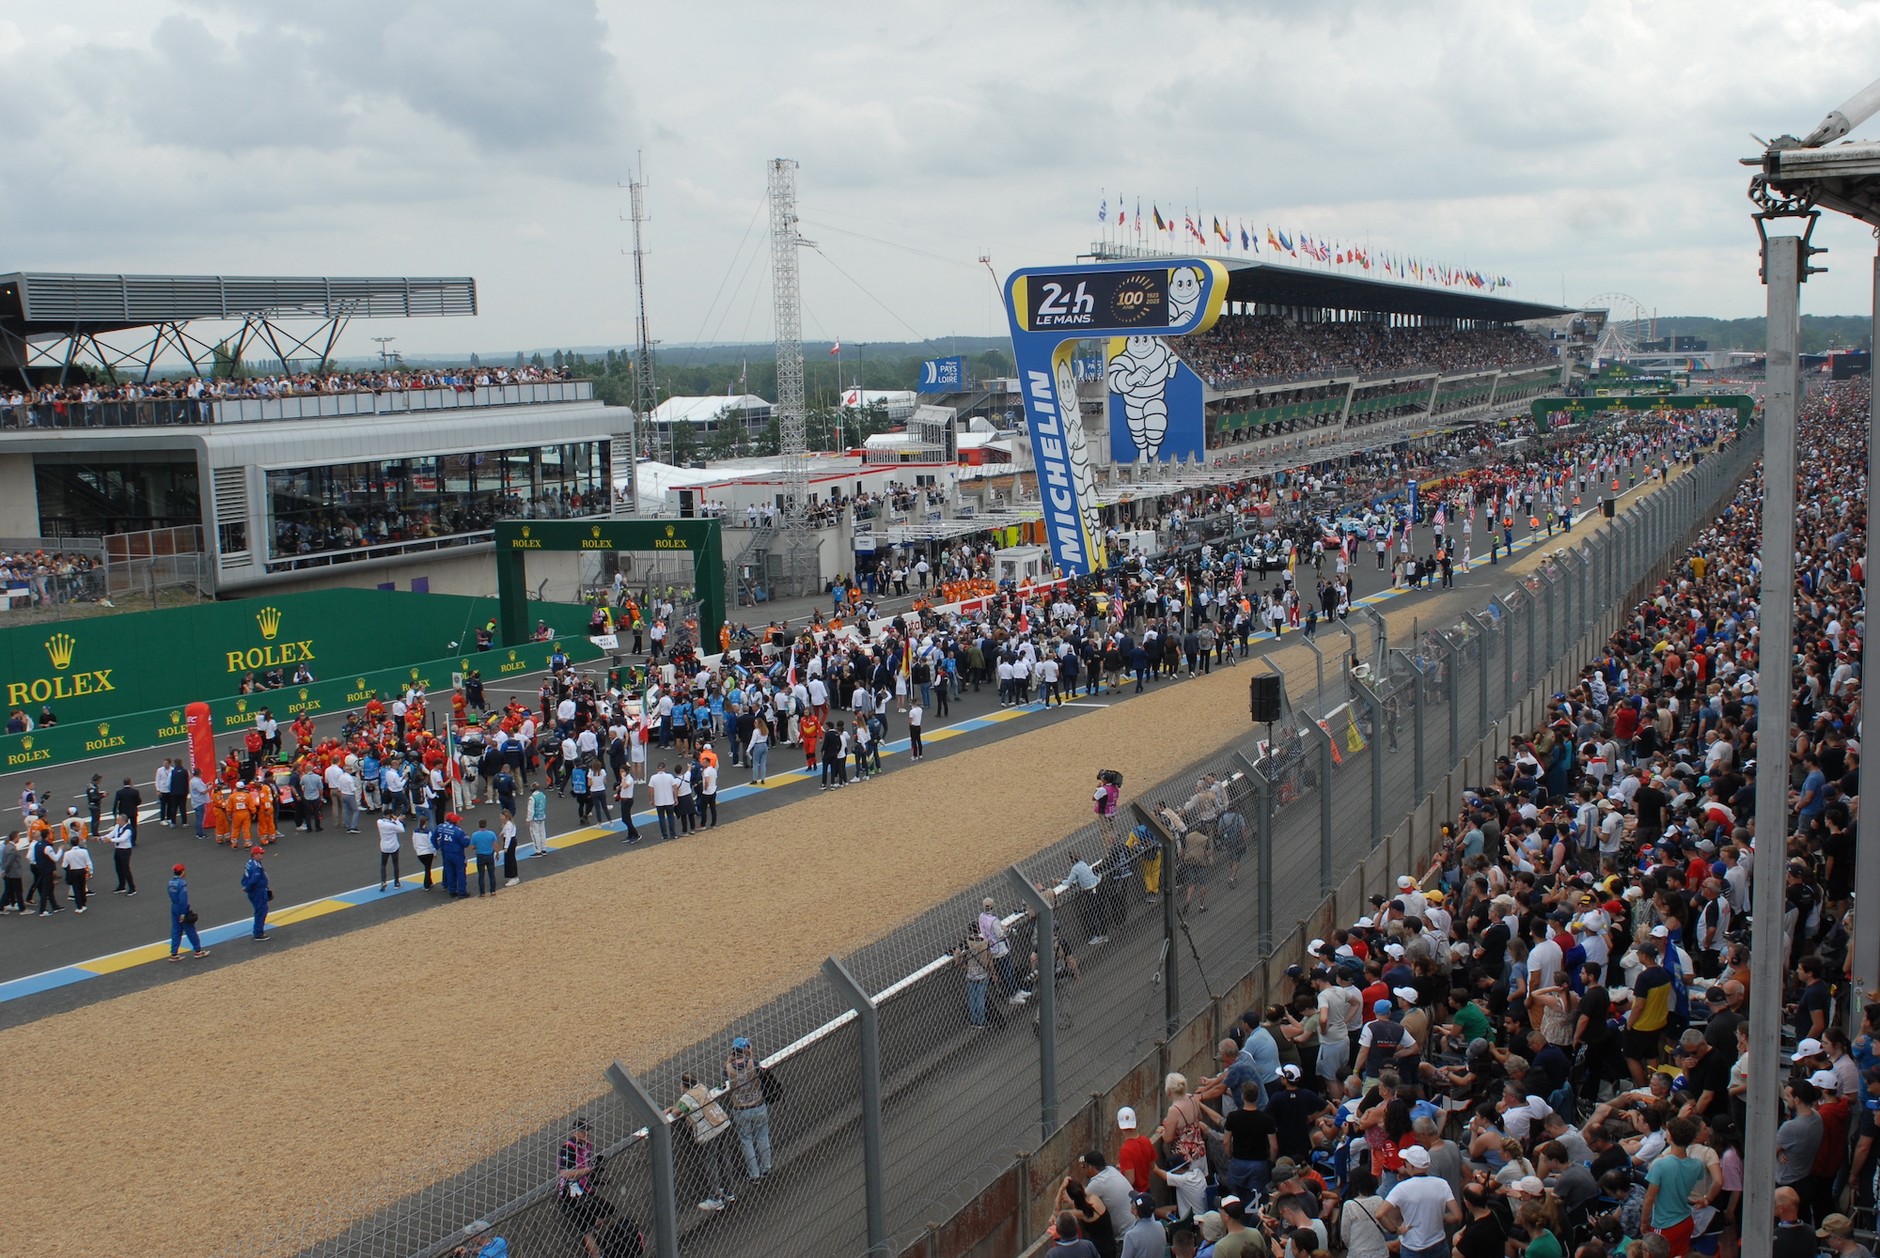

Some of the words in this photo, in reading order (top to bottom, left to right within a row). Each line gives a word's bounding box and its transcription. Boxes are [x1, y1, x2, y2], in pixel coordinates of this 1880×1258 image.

[1038, 281, 1094, 315] 24h
[1117, 291, 1144, 305] 100
[1036, 315, 1052, 325] LE
[1053, 314, 1092, 324] MANS
[940, 365, 957, 373] PAYS
[937, 375, 958, 384] LOIRE
[1027, 370, 1083, 564] MICHELIN
[512, 539, 541, 548] ROLEX
[582, 539, 613, 548] ROLEX
[655, 539, 688, 548] ROLEX
[227, 640, 316, 673] ROLEX
[501, 660, 526, 673] ROLEX
[7, 668, 116, 707] ROLEX
[288, 699, 322, 714] ROLEX
[158, 724, 188, 739] ROLE
[85, 735, 126, 752] ROLEX
[8, 749, 51, 766] ROLEX
